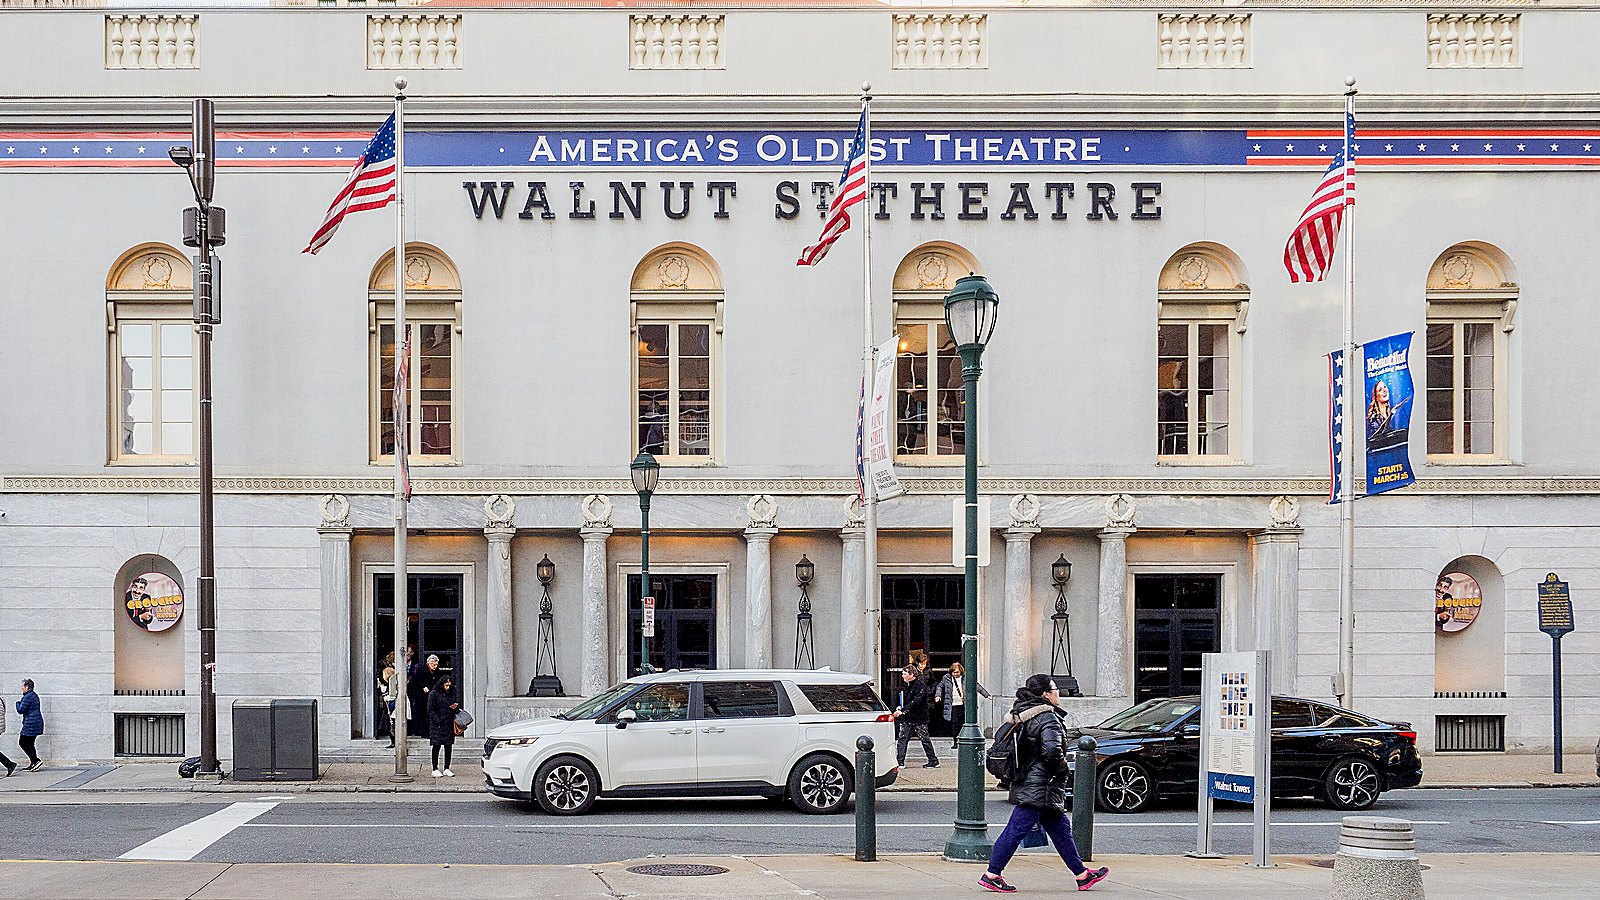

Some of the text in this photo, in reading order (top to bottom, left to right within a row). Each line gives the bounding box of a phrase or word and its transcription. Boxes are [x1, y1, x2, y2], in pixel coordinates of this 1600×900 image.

[528, 135, 739, 162] AMERICA'S
[925, 133, 1101, 161] THEATRE
[462, 181, 737, 220] WALNUT
[870, 182, 1162, 220] THEATRE
[1378, 464, 1402, 475] STARTS
[1374, 473, 1400, 484] MARCH
[1436, 598, 1481, 607] ROUCHO
[1215, 781, 1251, 794] Walnut Towers
